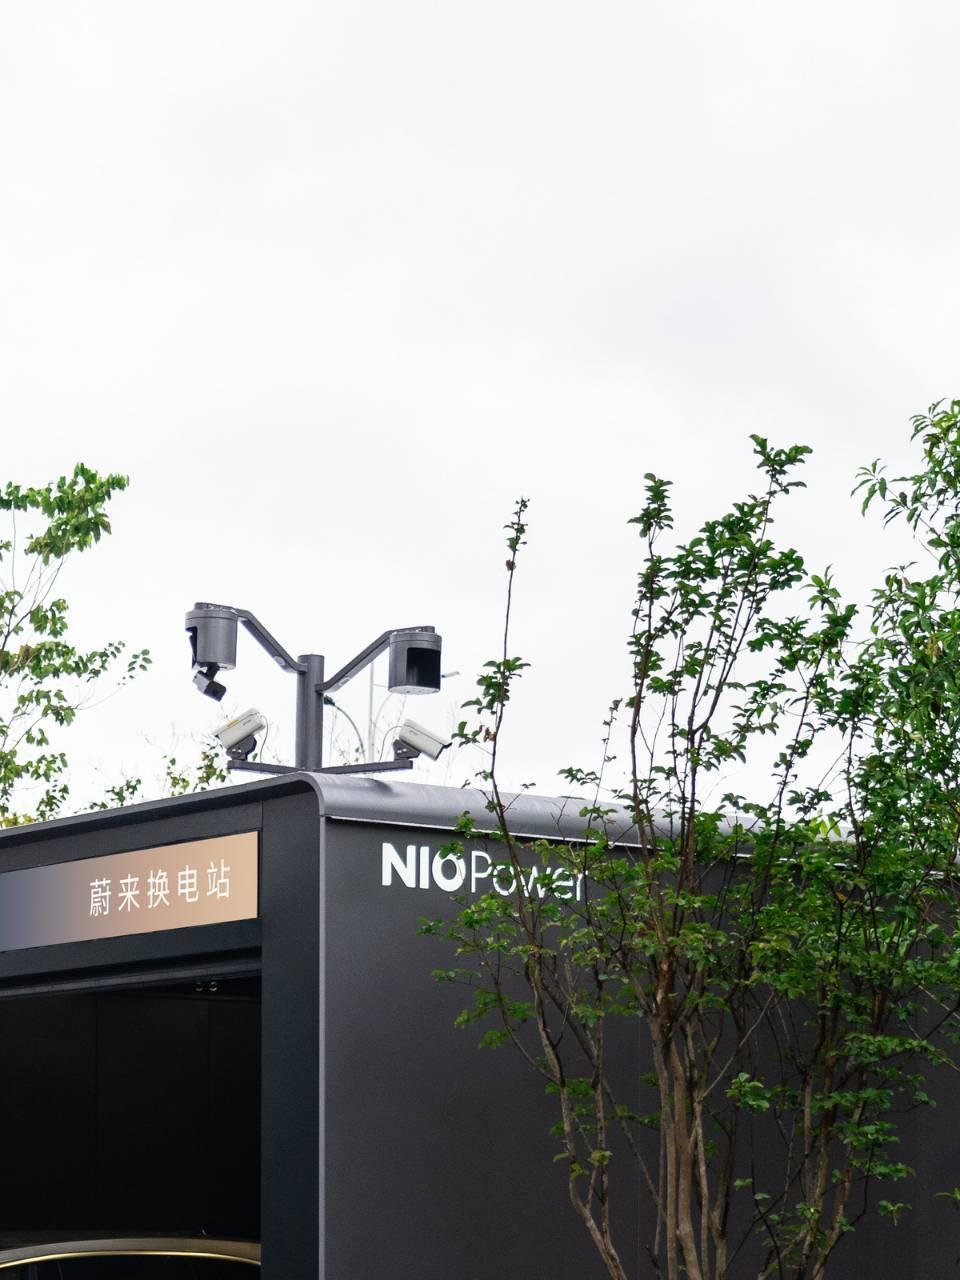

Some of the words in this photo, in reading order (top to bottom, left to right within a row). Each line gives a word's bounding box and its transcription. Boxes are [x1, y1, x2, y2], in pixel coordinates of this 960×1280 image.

[89, 859, 232, 918] 蔚来换电站
